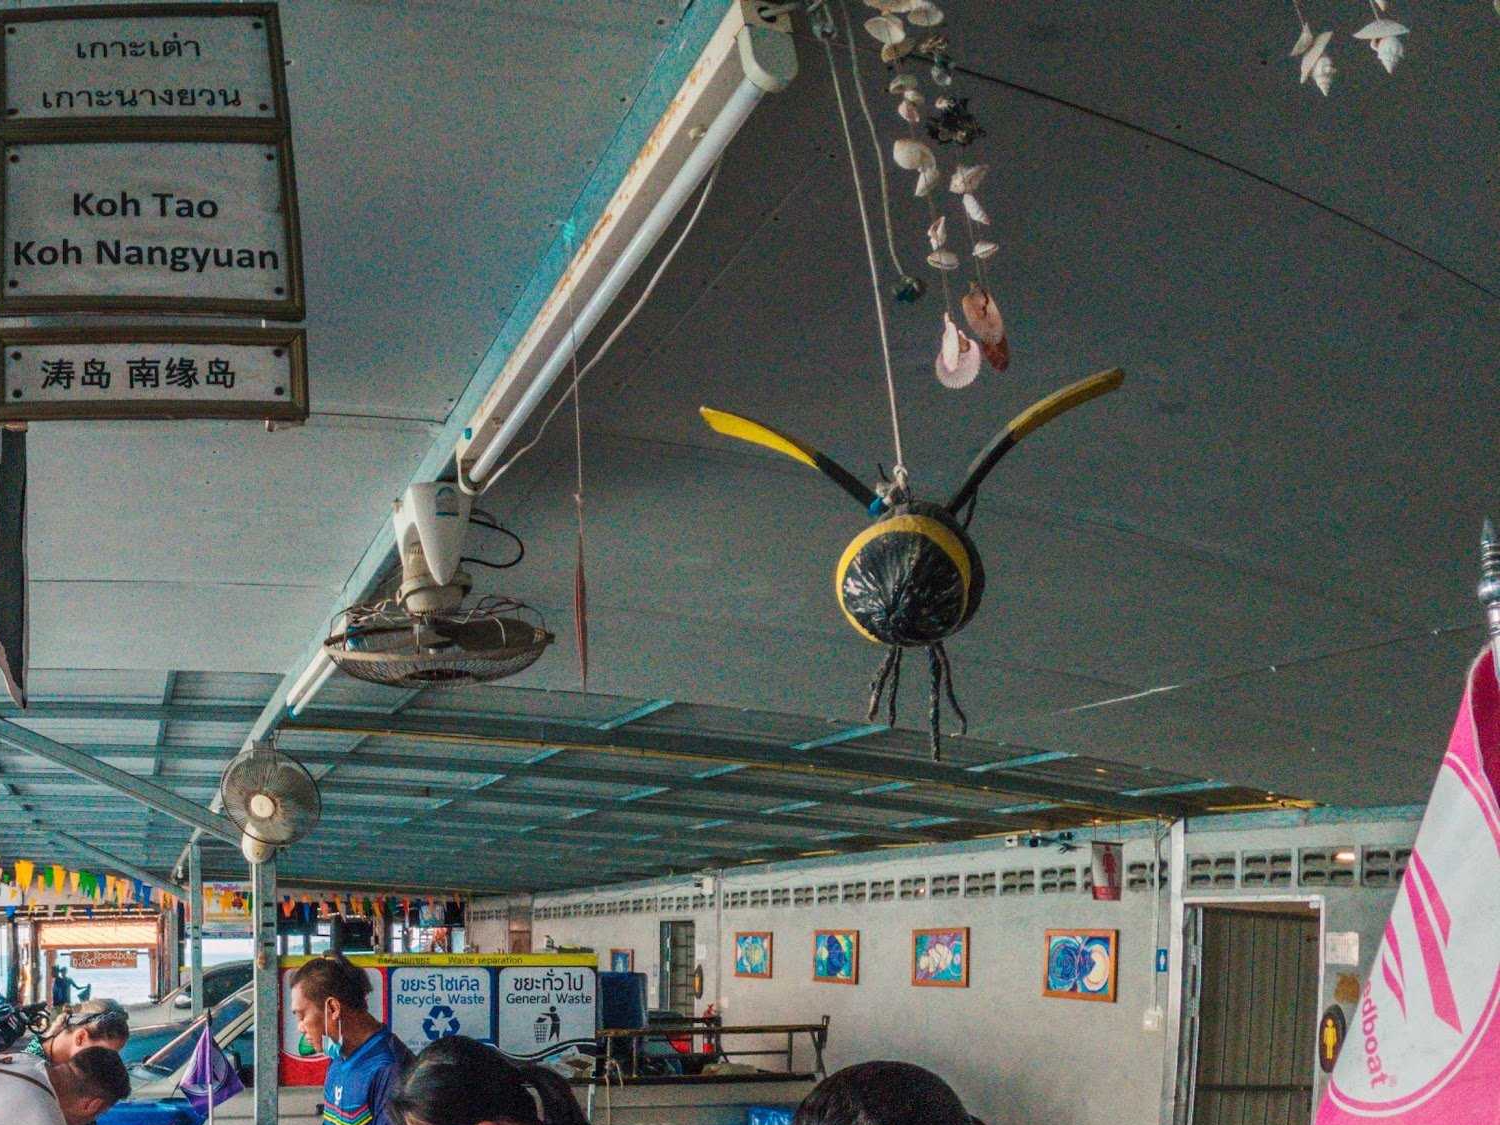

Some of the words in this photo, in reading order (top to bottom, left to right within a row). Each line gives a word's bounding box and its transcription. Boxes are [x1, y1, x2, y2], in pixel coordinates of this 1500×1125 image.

[76, 32, 201, 59] เกาะเต่า
[42, 87, 242, 109] เกาะนางยวน
[73, 192, 141, 217] Koh
[152, 192, 218, 219] Tao
[14, 239, 82, 266] Koh
[96, 240, 280, 273] Nangyuan
[40, 358, 111, 389] 涛岛
[127, 357, 236, 389] 南缘岛
[448, 956, 475, 964] Waste
[478, 956, 523, 966] separation
[513, 969, 584, 992] ขยะทั่วไป
[397, 994, 442, 1007] Recycle
[447, 994, 485, 1005] Waste
[506, 993, 550, 1004] General
[556, 994, 592, 1005] Waste
